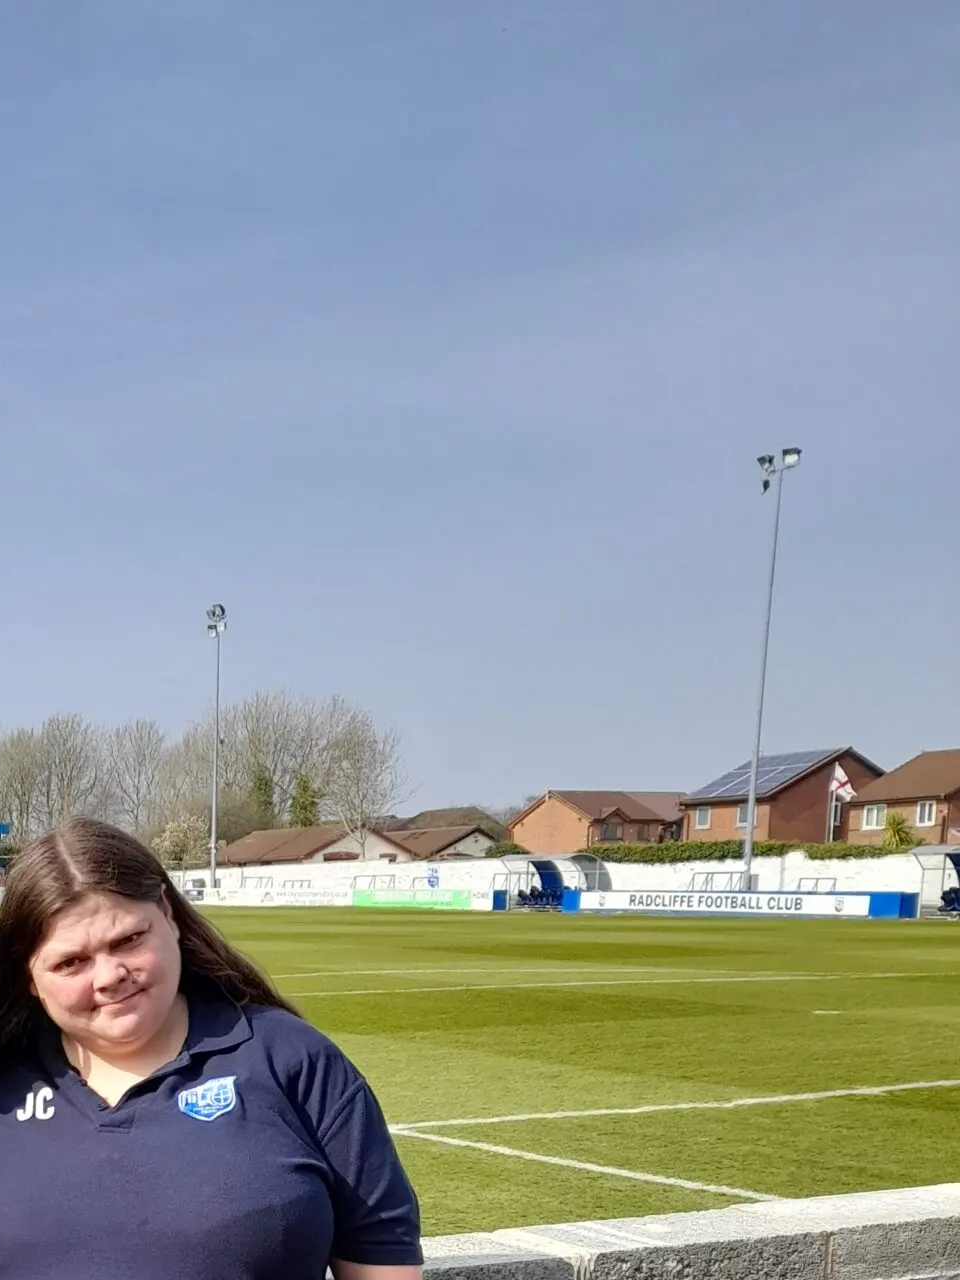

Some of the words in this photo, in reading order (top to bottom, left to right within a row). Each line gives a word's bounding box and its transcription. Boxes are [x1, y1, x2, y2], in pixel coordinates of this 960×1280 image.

[628, 894, 694, 909] RADCLIFFE
[697, 895, 763, 911] FOOTBALL
[766, 897, 803, 912] CLUB
[16, 1086, 55, 1122] JC
